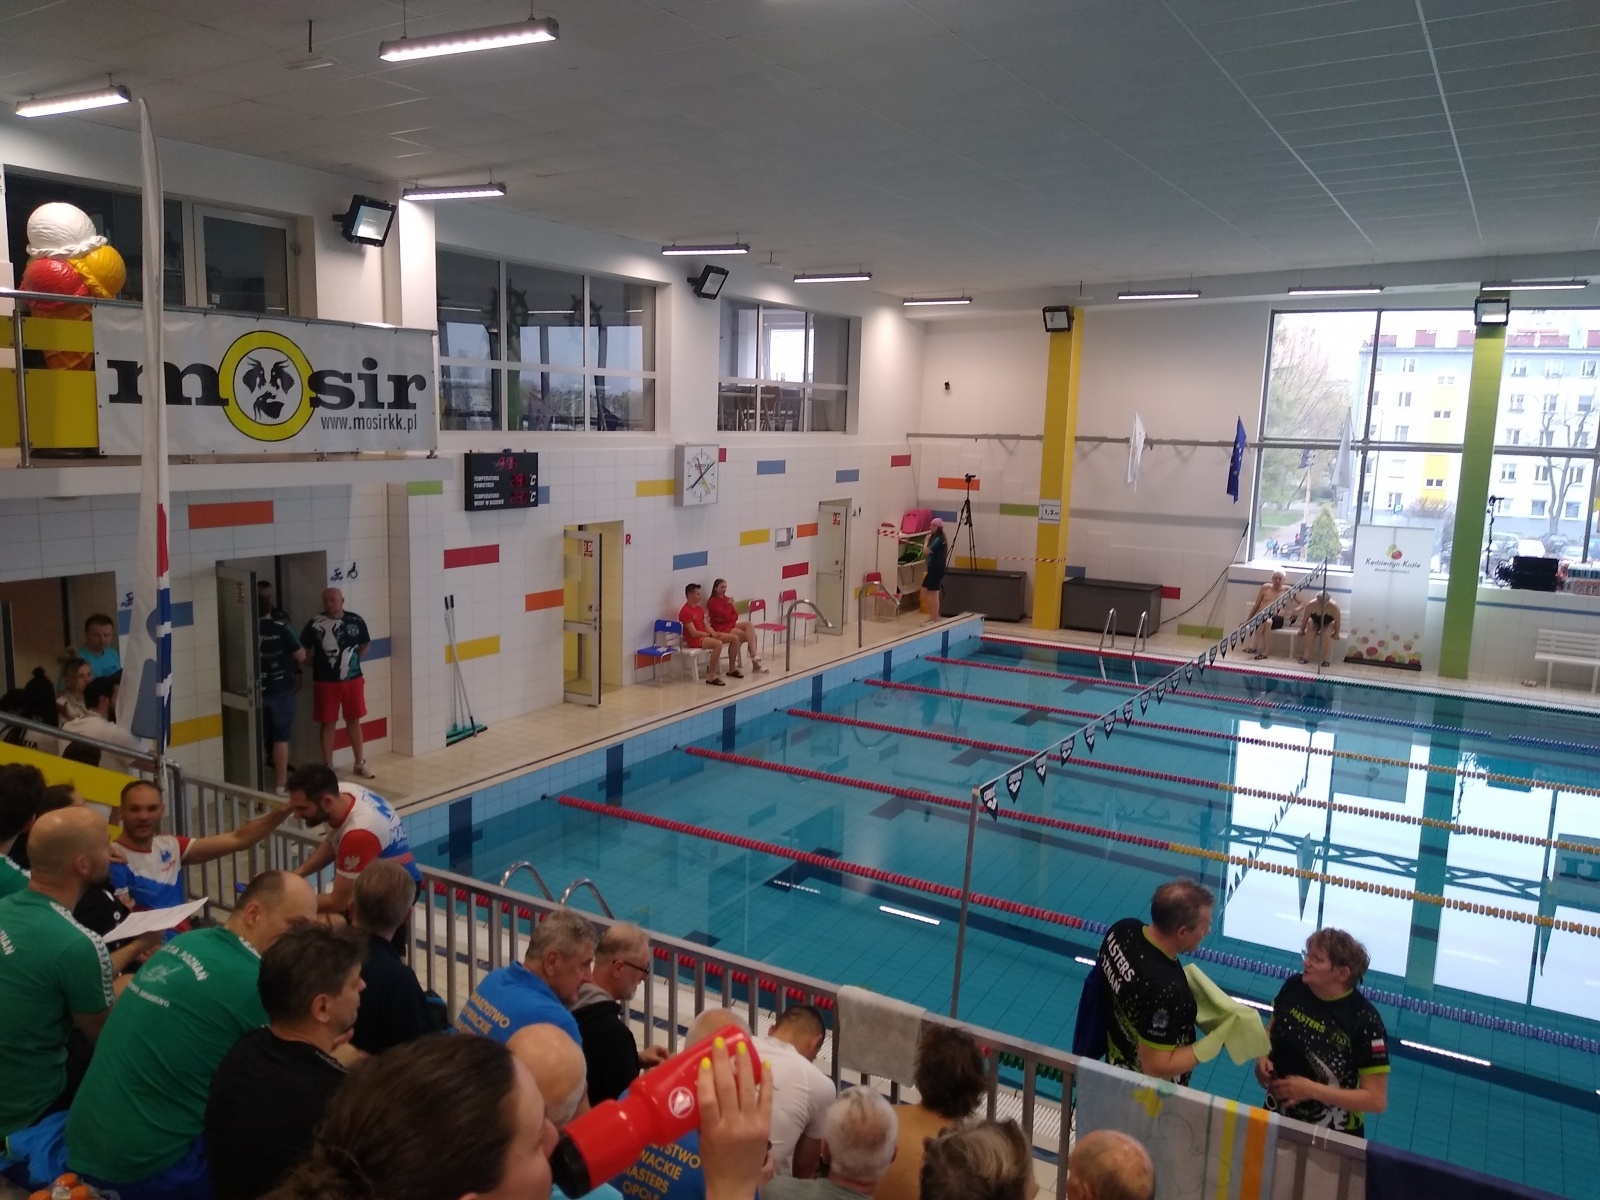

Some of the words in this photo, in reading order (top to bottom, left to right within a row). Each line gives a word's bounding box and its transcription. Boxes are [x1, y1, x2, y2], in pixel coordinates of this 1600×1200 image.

[321, 413, 417, 433] www.mosirkk.pl
[625, 533, 632, 546] R
[1289, 1007, 1327, 1034] MASTERS
